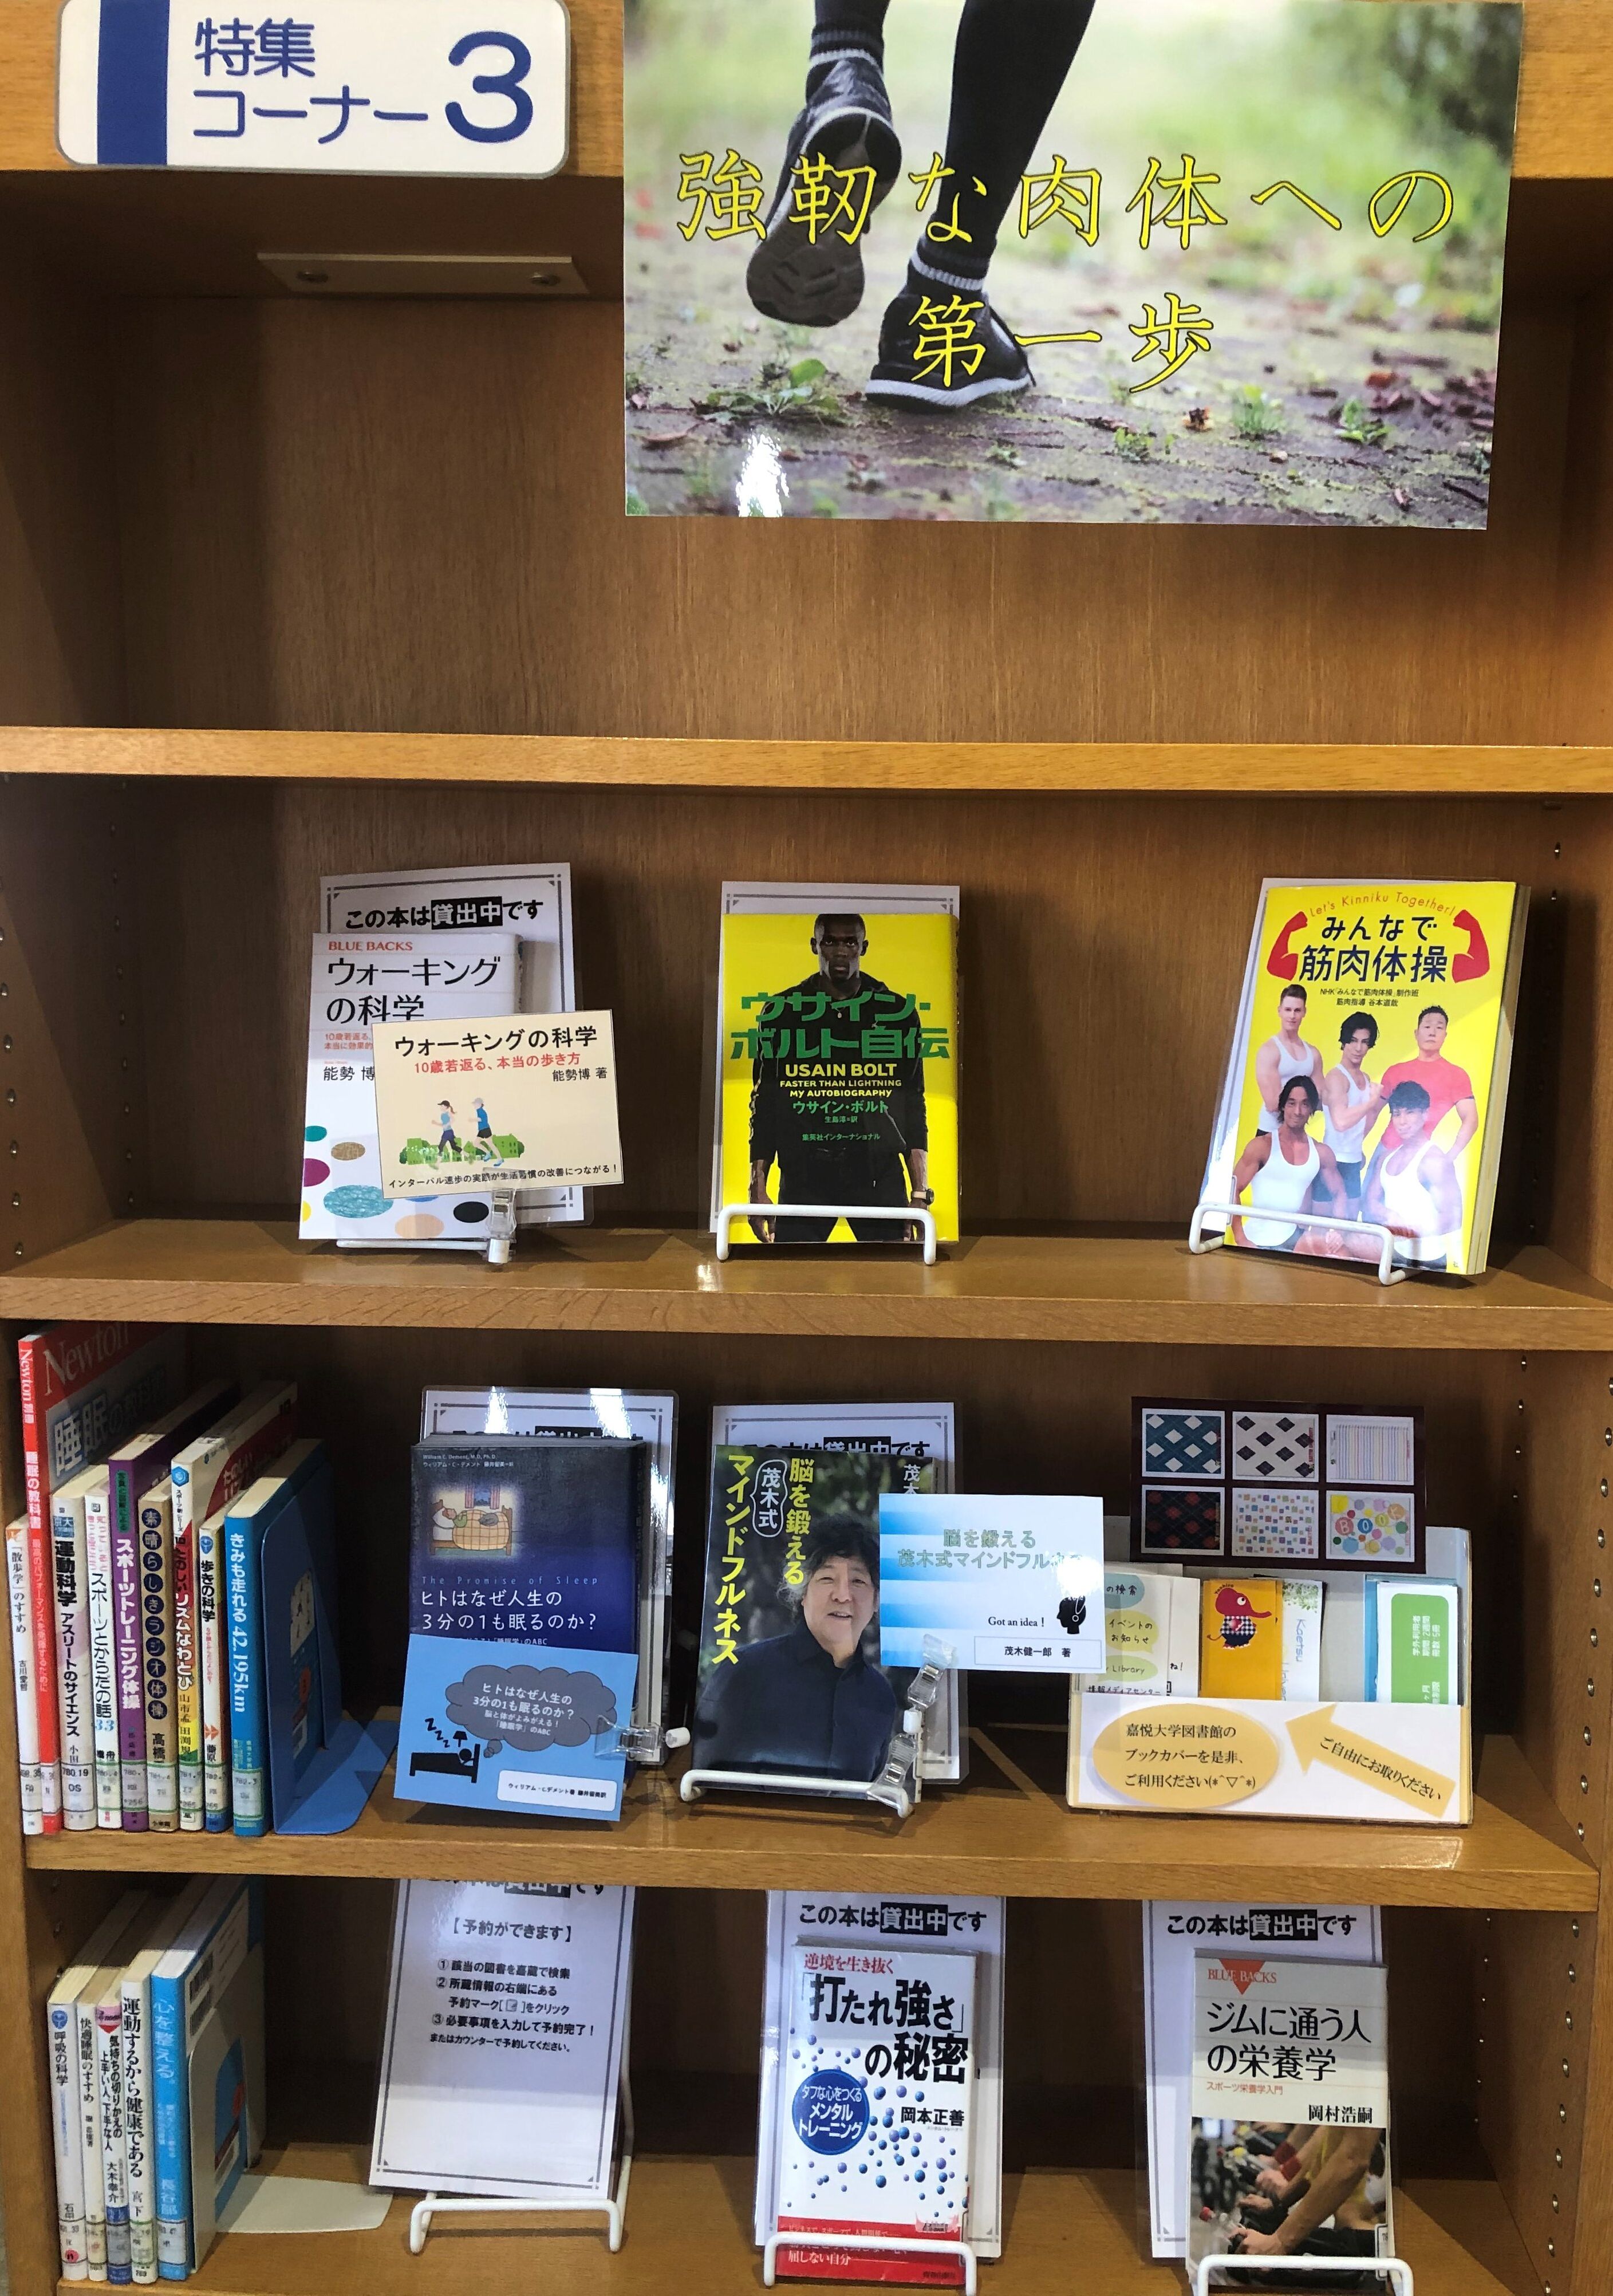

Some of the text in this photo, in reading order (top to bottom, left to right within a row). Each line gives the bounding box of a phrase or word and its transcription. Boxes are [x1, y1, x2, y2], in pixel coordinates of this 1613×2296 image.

[195, 18, 315, 78] 特集
[444, 30, 534, 144] 3
[193, 85, 428, 144] コーナー
[908, 292, 1215, 393] 第一歩
[345, 900, 543, 929] この本は貸出中です
[1310, 891, 1456, 917] Let's Kinniku Together!
[1322, 915, 1437, 941] みんなで
[328, 941, 413, 951] BLUE BACKS
[328, 956, 501, 987] ウォーキング
[1299, 944, 1448, 982] 筋肉体操
[326, 994, 424, 1025] の科学
[395, 1025, 597, 1057] ウォーキングの科学
[730, 1027, 949, 1060] ボルト自伝
[324, 1066, 355, 1081] 能勢
[415, 1053, 581, 1074] 10歳若返る、本当の歩き方
[552, 1067, 608, 1082] 能勢博 著
[785, 1064, 897, 1077] USAIN BOLT
[792, 1100, 889, 1114] ウサイン・ボルト
[44, 1322, 129, 1396] Newton
[759, 1467, 782, 1529] 茂木式
[783, 1458, 814, 1585] 脳を鍛える
[944, 1529, 1036, 1548] 脳を鍛える
[55, 1540, 77, 1607] 運動科学
[712, 1455, 755, 1665] マインドフルネス
[898, 1549, 1082, 1569] 茂木式マインドフル
[201, 1560, 215, 1623] 歩きの科学
[423, 1576, 598, 1585] The Promise of Sleep
[422, 1589, 562, 1607] ヒトはなぜ人生の
[116, 1539, 141, 1709] スポーツトレーニング体操
[144, 1511, 167, 1716] 素晴らしきラジオ体操
[230, 1533, 249, 1712] きみも走れる 42.195km
[988, 1617, 1005, 1626] Got
[1109, 1618, 1153, 1629] イベントの
[91, 1573, 113, 1718] スポーツとからだの話
[1004, 1646, 1071, 1657] 茂木健一郎 著
[1111, 1633, 1149, 1644] お知らせ
[1296, 1618, 1306, 1662] Kaetsu
[61, 1612, 80, 1736] アスリートのサイエンス
[1113, 1665, 1145, 1675] Library
[483, 1683, 572, 1705] ヒトはなぜ人生の
[1126, 1723, 1237, 1739] 嘉悦大学図書館の
[152, 1733, 165, 1763] 高橋
[1126, 1748, 1244, 1765] ブックカバーを是非、
[1320, 1736, 1441, 1800] ご自由にお取りください
[453, 1917, 572, 1942] 【予約ができます】
[799, 1904, 987, 1934] この本は貸出中です
[1168, 1914, 1356, 1937] この本は貸出中です
[804, 1954, 894, 1974] 逆境を生き抜く
[1208, 1968, 1277, 1983] BLUE BACKS
[802, 1972, 964, 2033] 「打たれ強さ」
[1207, 2002, 1371, 2043] ジムに通う人
[430, 2033, 570, 2053] またはカウンターで予約してください。
[54, 2031, 69, 2086] 呼吸の科学
[80, 2017, 94, 2103] 快適睡眠のすすめ
[865, 2032, 969, 2085] の秘密
[1207, 2043, 1336, 2082] の栄養学
[123, 1997, 144, 2177] 運動するから健康である
[802, 2085, 862, 2102] タフな心をつくる
[1206, 2081, 1283, 2096] スポーツ栄養学入門
[810, 2102, 854, 2121] メンタル
[901, 2106, 965, 2126] 岡本正善
[1308, 2105, 1373, 2124] 岡村浩嗣
[799, 2119, 863, 2139] トレーニング
